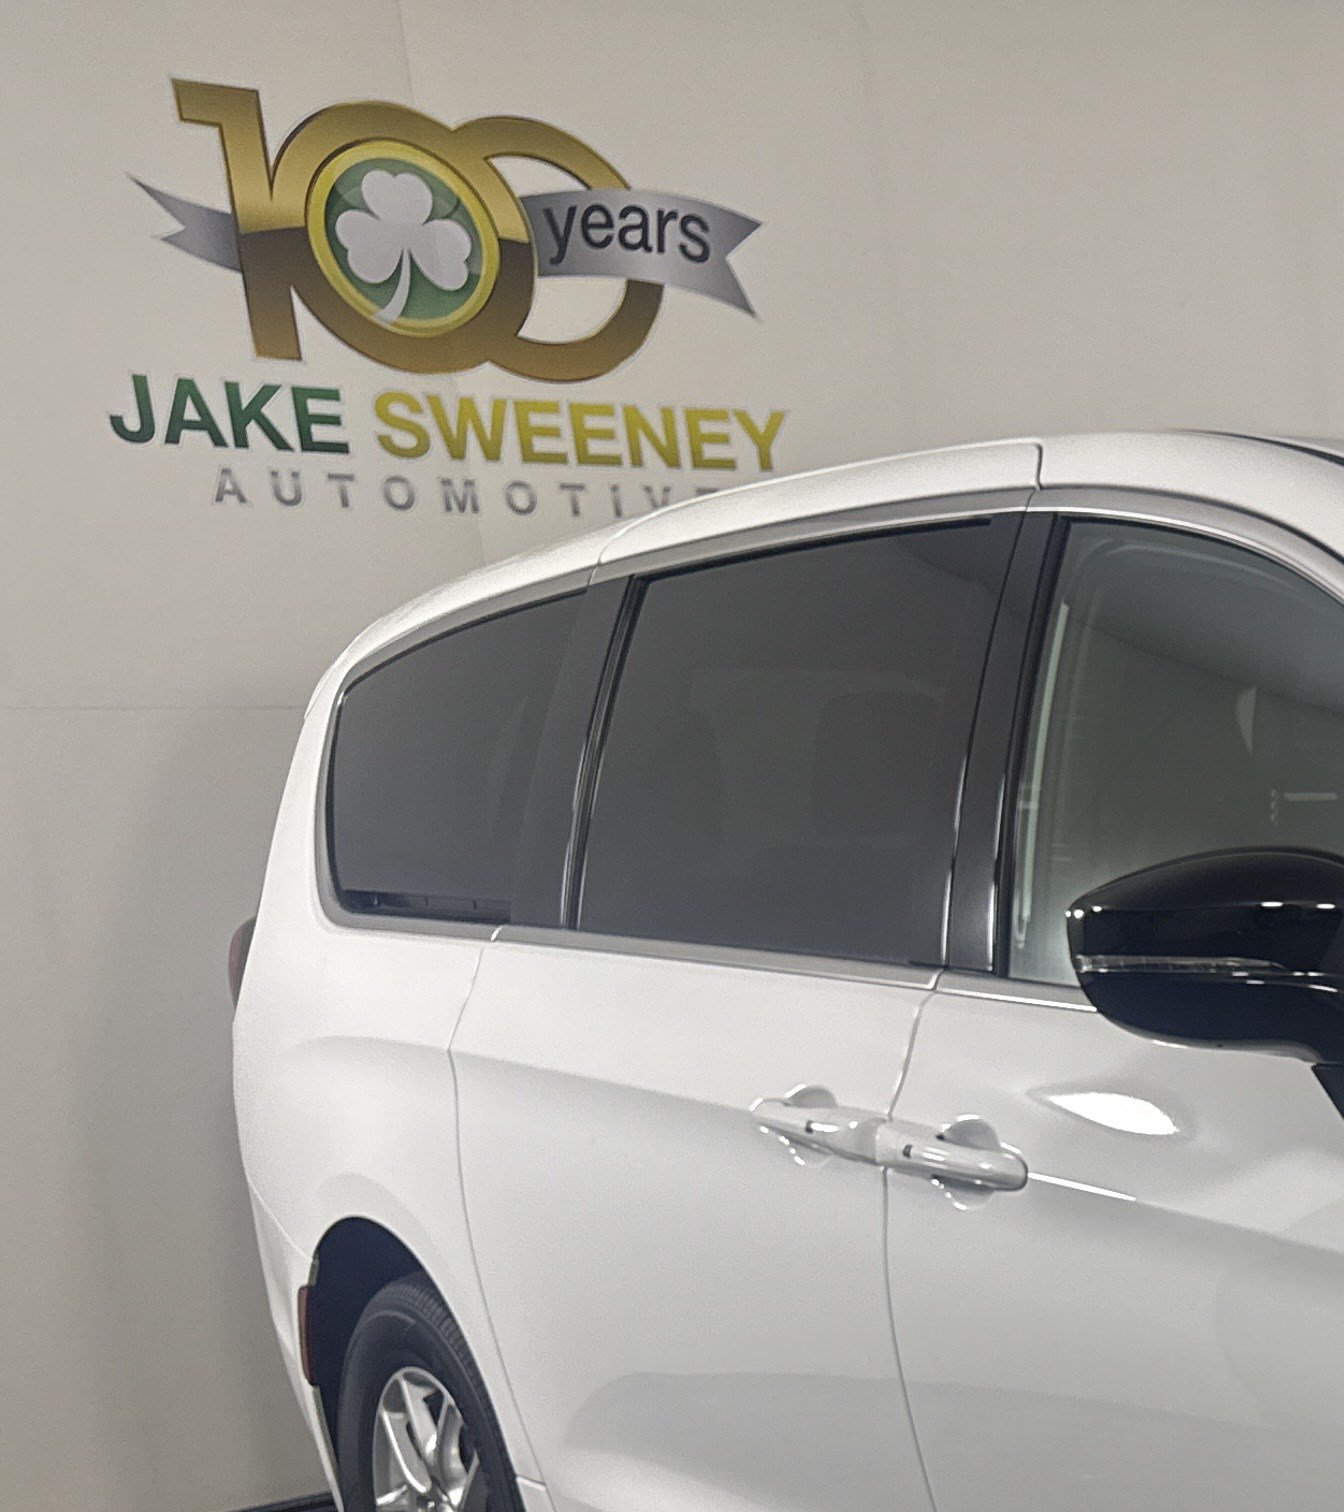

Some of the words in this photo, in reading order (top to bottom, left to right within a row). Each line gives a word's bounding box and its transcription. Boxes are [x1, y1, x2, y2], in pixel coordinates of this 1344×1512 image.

[544, 203, 711, 266] years
[109, 374, 350, 455] JAKE
[373, 390, 787, 472] SWEENEY
[214, 467, 718, 517] AUTOMOTIV
